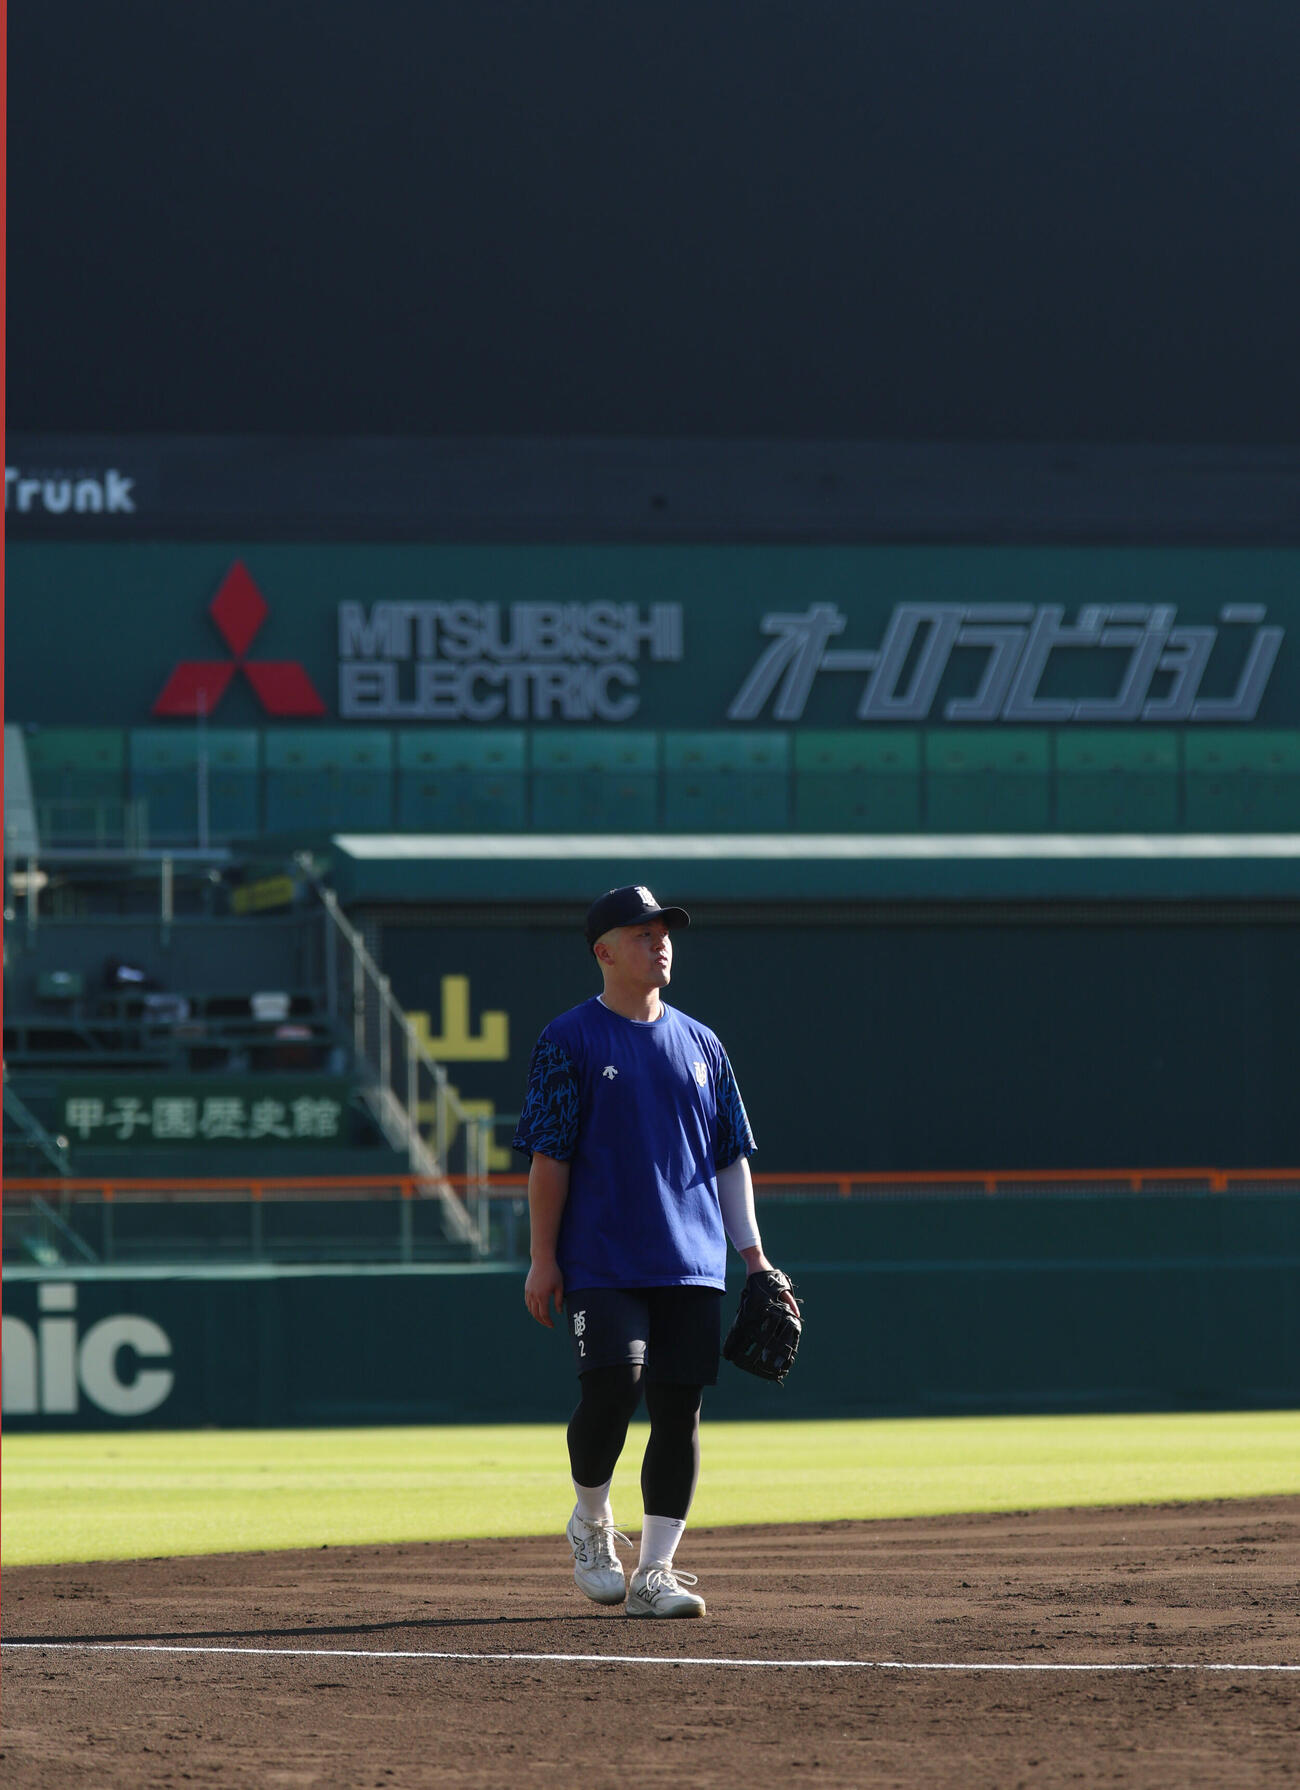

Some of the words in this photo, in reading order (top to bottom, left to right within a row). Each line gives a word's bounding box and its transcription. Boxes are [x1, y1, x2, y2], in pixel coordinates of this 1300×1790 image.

[338, 600, 684, 661] MITSUBISHI
[338, 662, 640, 721] ELECTRIC
[578, 1340, 586, 1357] 2
